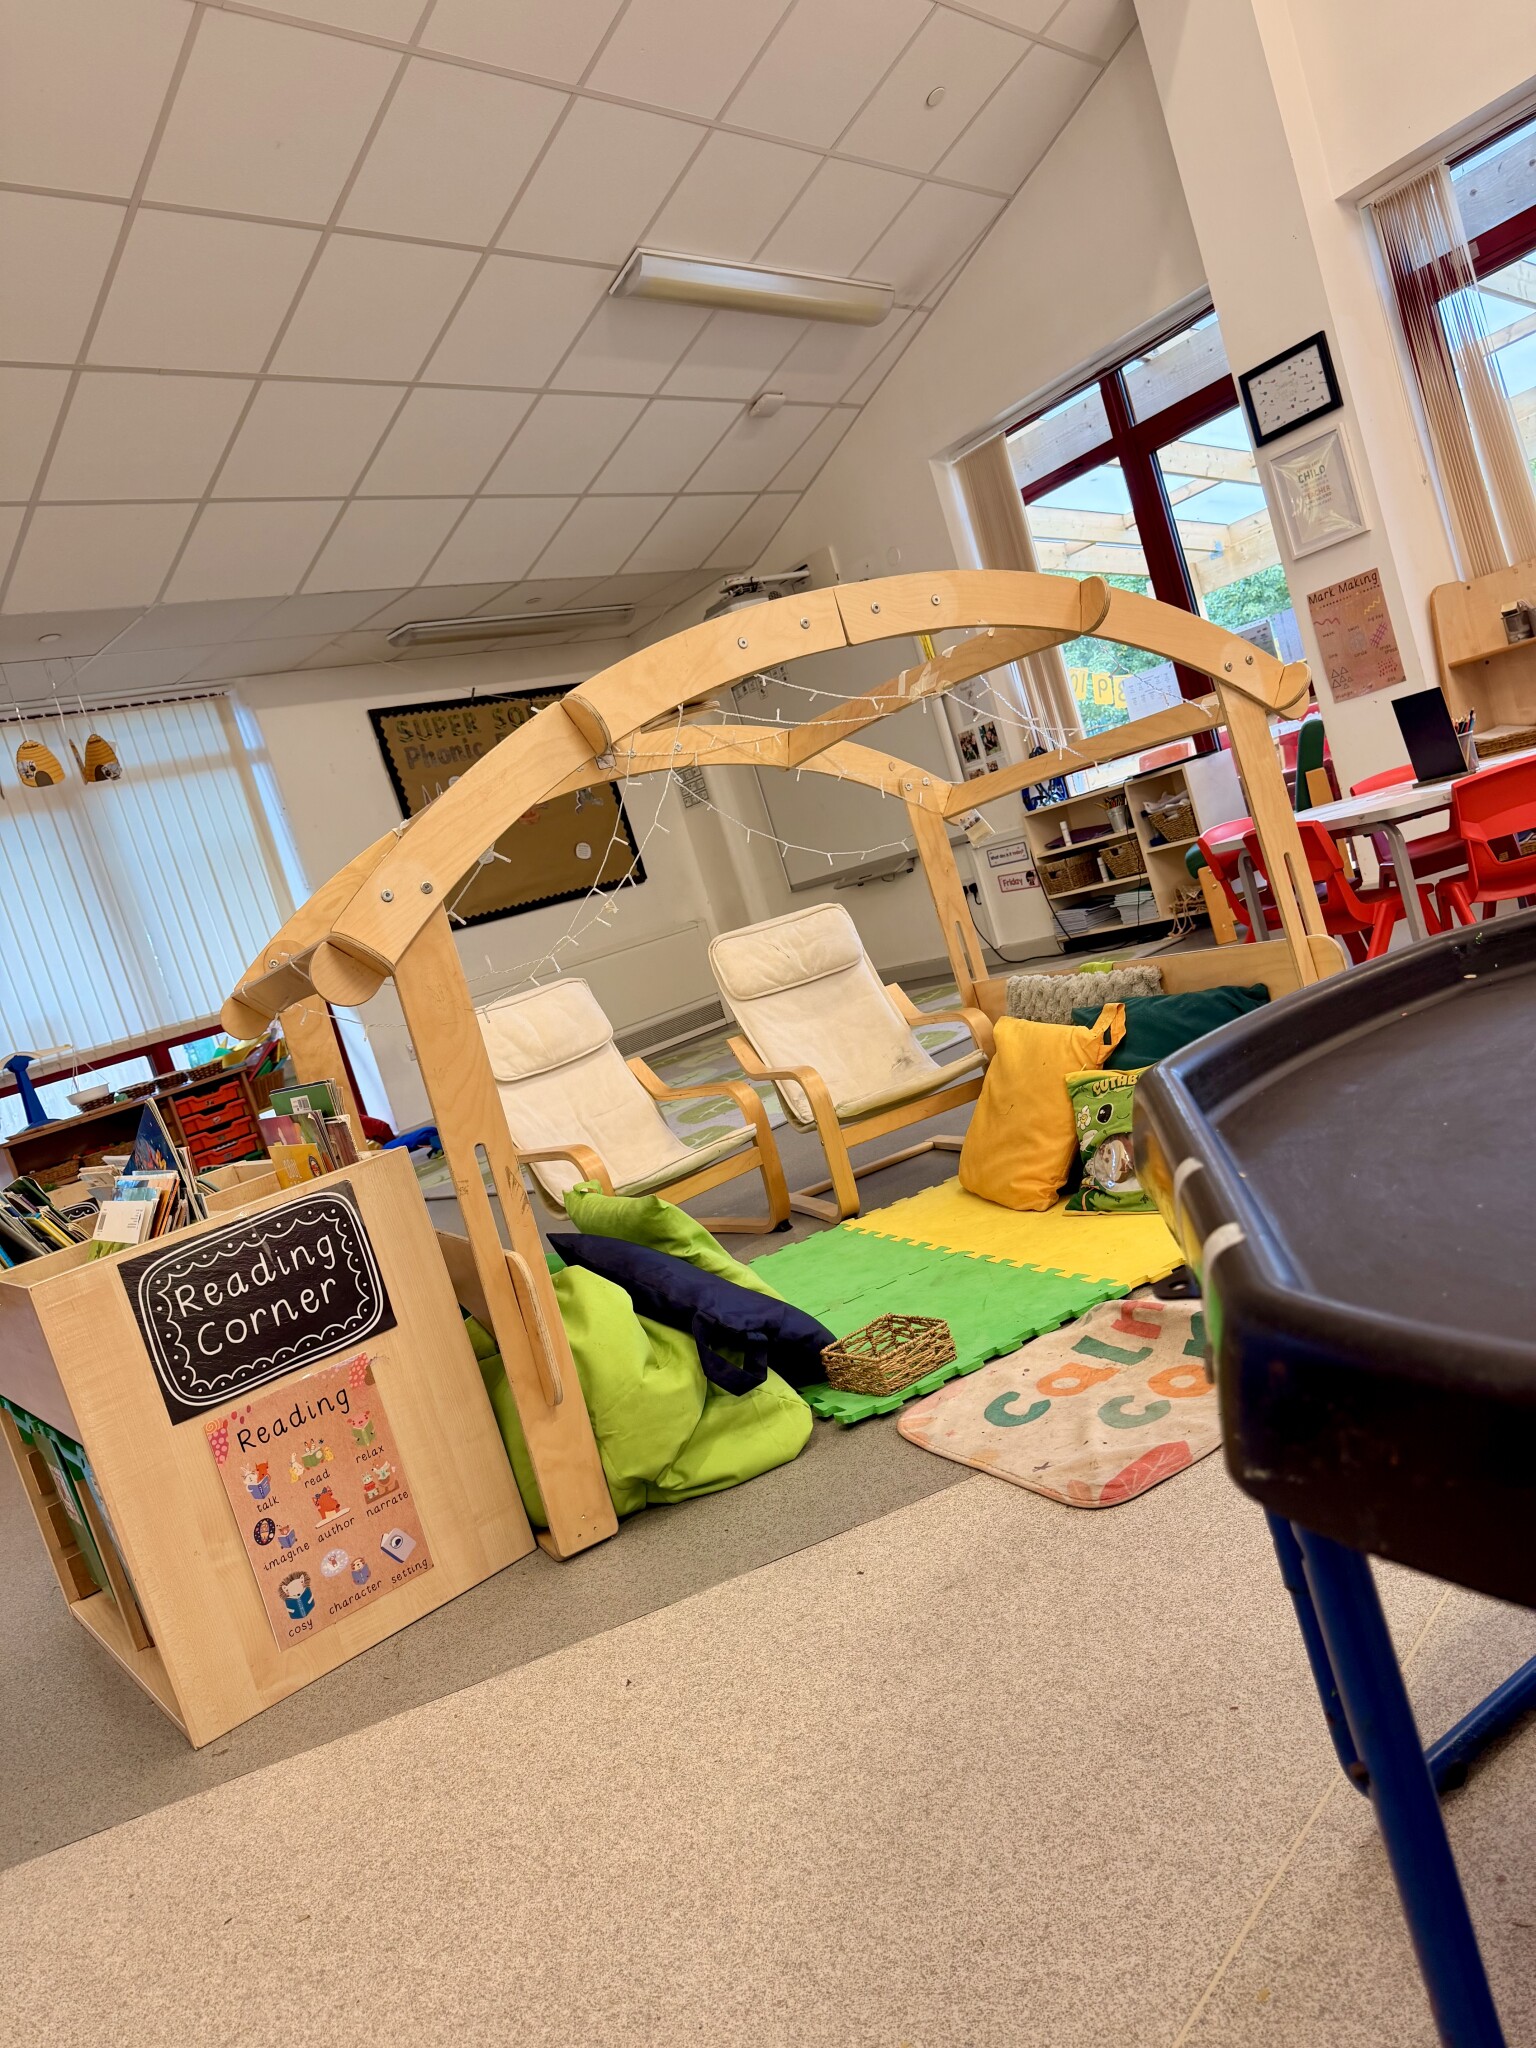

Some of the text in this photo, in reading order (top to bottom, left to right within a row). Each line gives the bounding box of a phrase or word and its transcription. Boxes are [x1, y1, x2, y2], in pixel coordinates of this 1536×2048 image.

[1298, 465, 1326, 483] CHILD
[1308, 571, 1378, 605] Mark Making
[396, 711, 479, 743] SUPER
[404, 736, 484, 769] Phonic
[1002, 878, 1023, 888] Friday
[1092, 1074, 1137, 1096] CUTAB
[174, 1232, 337, 1318] Reading
[196, 1277, 337, 1356] Corner
[236, 1387, 351, 1453] Reading
[355, 1444, 385, 1464] relax
[304, 1469, 331, 1489] read
[256, 1494, 280, 1513] talk
[366, 1490, 409, 1518] narrate
[317, 1515, 356, 1544] author
[263, 1541, 311, 1572] imagine
[391, 1557, 429, 1585] setting
[328, 1579, 382, 1616] character
[288, 1618, 314, 1638] cosy
